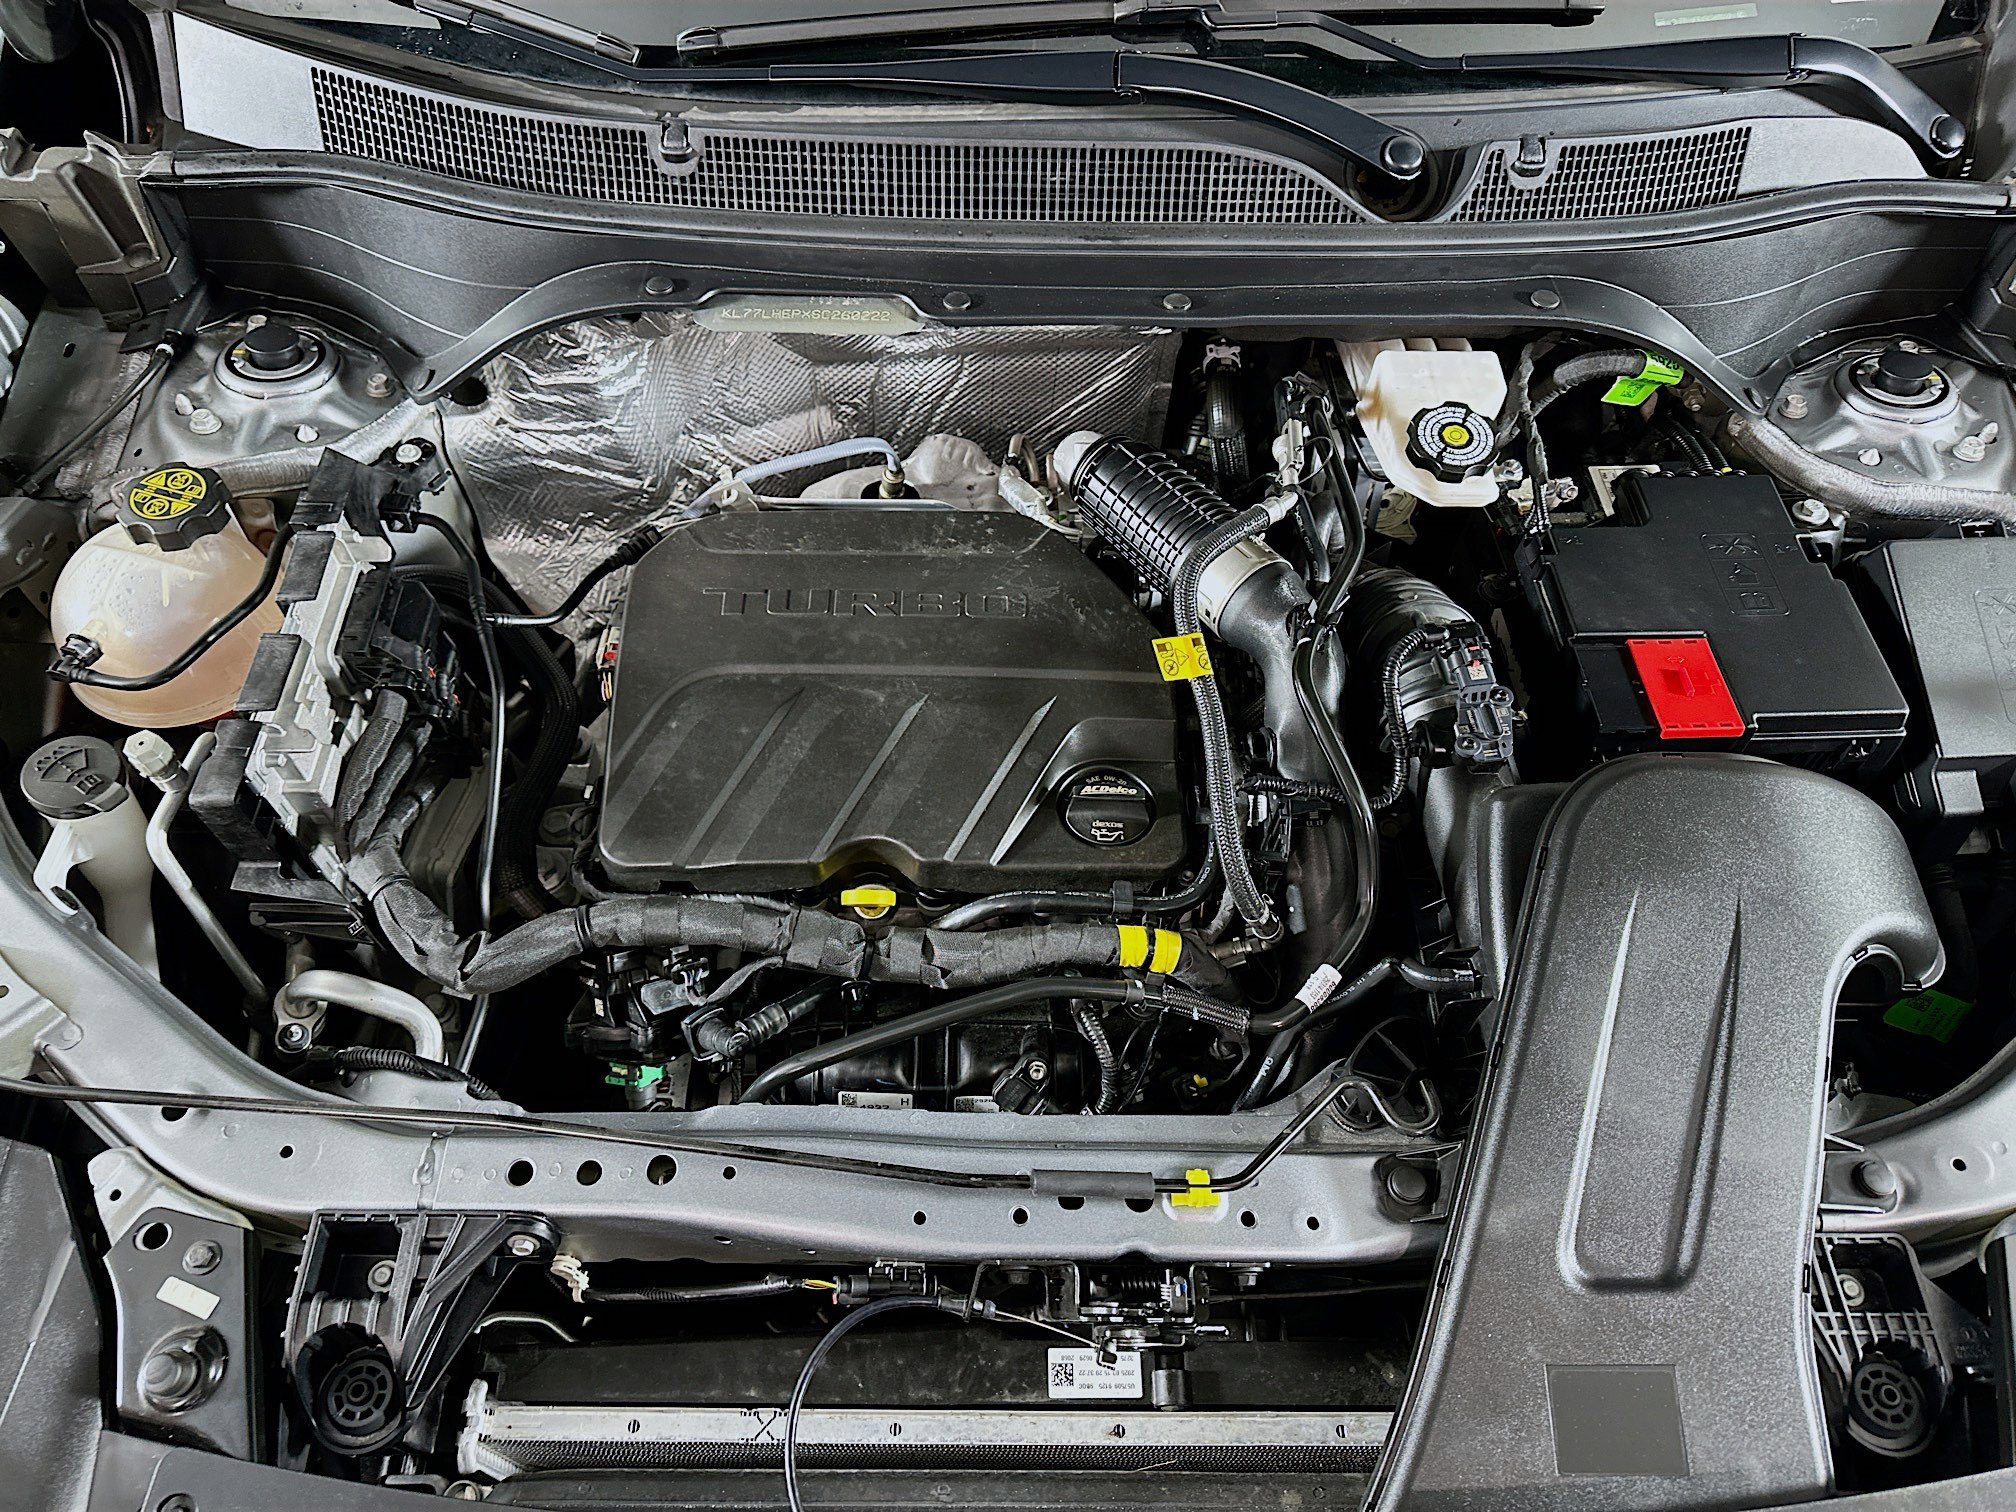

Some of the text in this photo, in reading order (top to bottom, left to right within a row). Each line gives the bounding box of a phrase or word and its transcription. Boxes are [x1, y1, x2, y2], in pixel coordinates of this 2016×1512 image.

[702, 587, 1028, 618] TURBO
[1086, 775, 1101, 784] SAE
[1080, 785, 1138, 796] ACDelco
[1092, 820, 1124, 829] dexos
[900, 1097, 910, 1106] H
